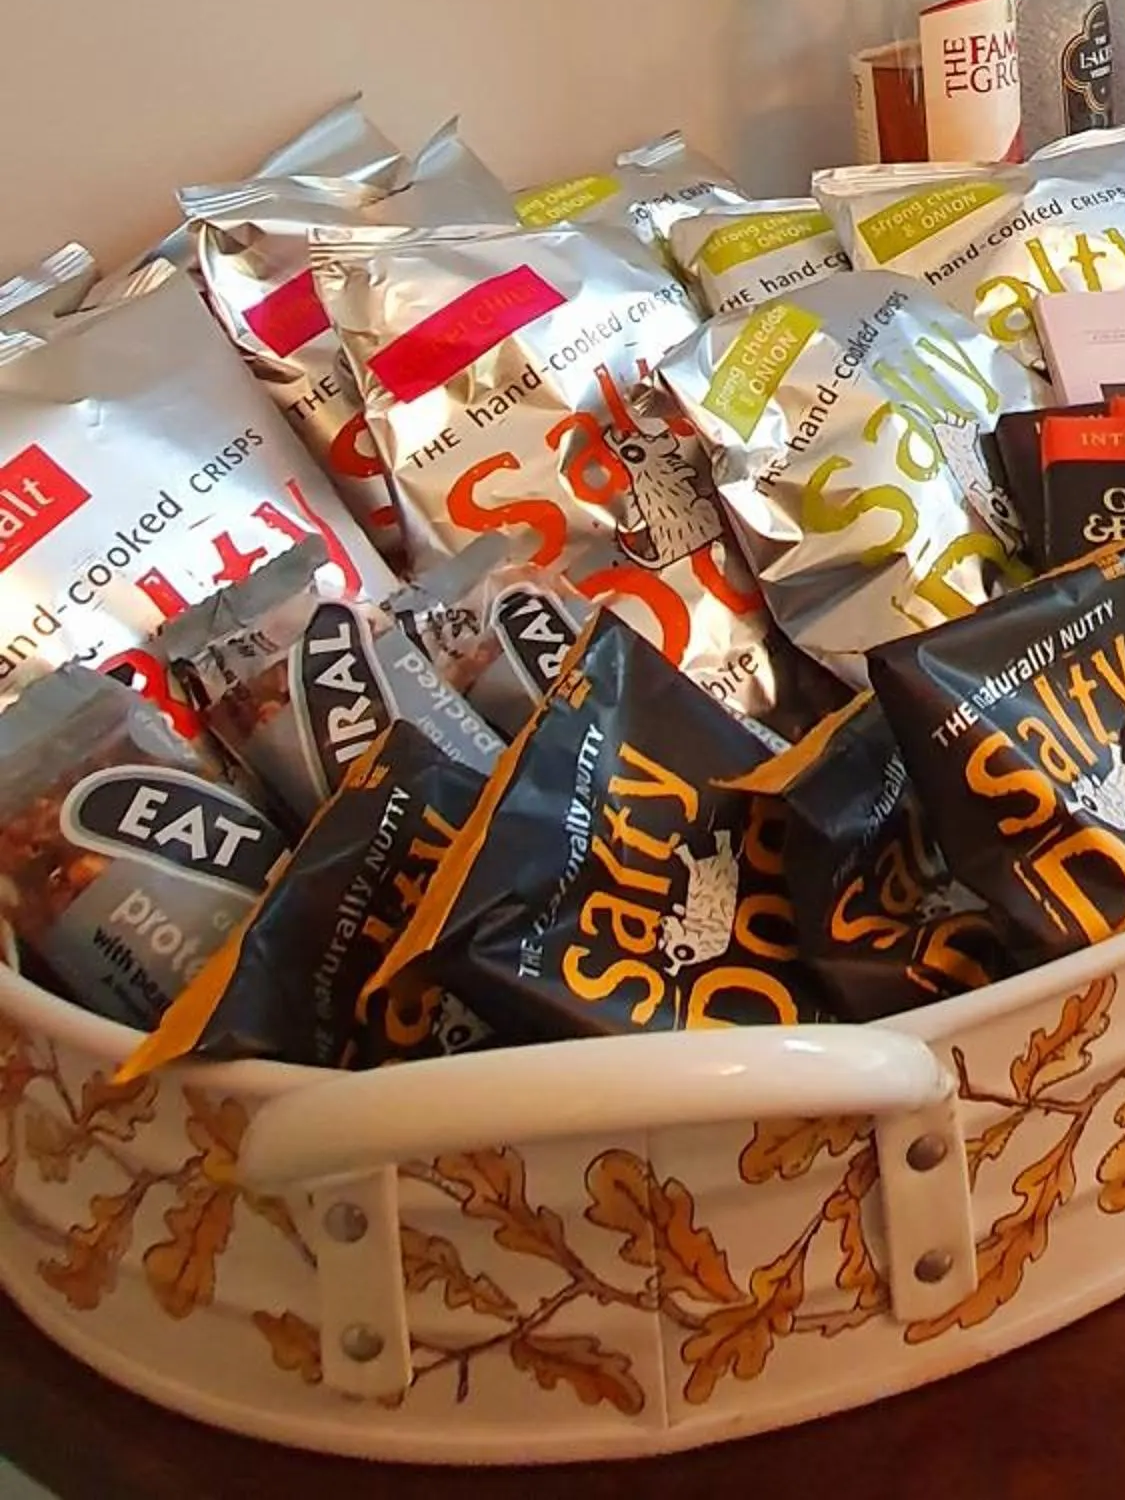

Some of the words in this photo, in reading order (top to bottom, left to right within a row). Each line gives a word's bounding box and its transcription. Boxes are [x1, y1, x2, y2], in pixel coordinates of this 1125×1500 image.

[943, 36, 969, 99] THE
[969, 30, 1019, 66] FAM
[970, 56, 1019, 93] GRO
[870, 202, 922, 238] strong
[920, 191, 979, 230] ONION
[923, 198, 1063, 286] hand-cooked
[288, 374, 341, 423] THE
[405, 426, 462, 470] THE
[465, 309, 623, 429] hand-cooked
[626, 282, 684, 324] CRISPS
[749, 329, 800, 396] ONION
[0, 476, 55, 555] alt
[753, 457, 791, 498] THE
[0, 489, 184, 680] and-cooked
[188, 427, 264, 494] CRISPS
[393, 650, 500, 755] packed
[701, 647, 759, 703] bite
[931, 699, 980, 749] THE
[973, 634, 1056, 710] naturally
[1061, 598, 1117, 655] NUTTY
[117, 785, 261, 867] EAT
[364, 785, 411, 873] NUTTY
[517, 937, 545, 979] THE
[576, 722, 606, 799] NUTTY
[560, 740, 699, 1027] Salty
